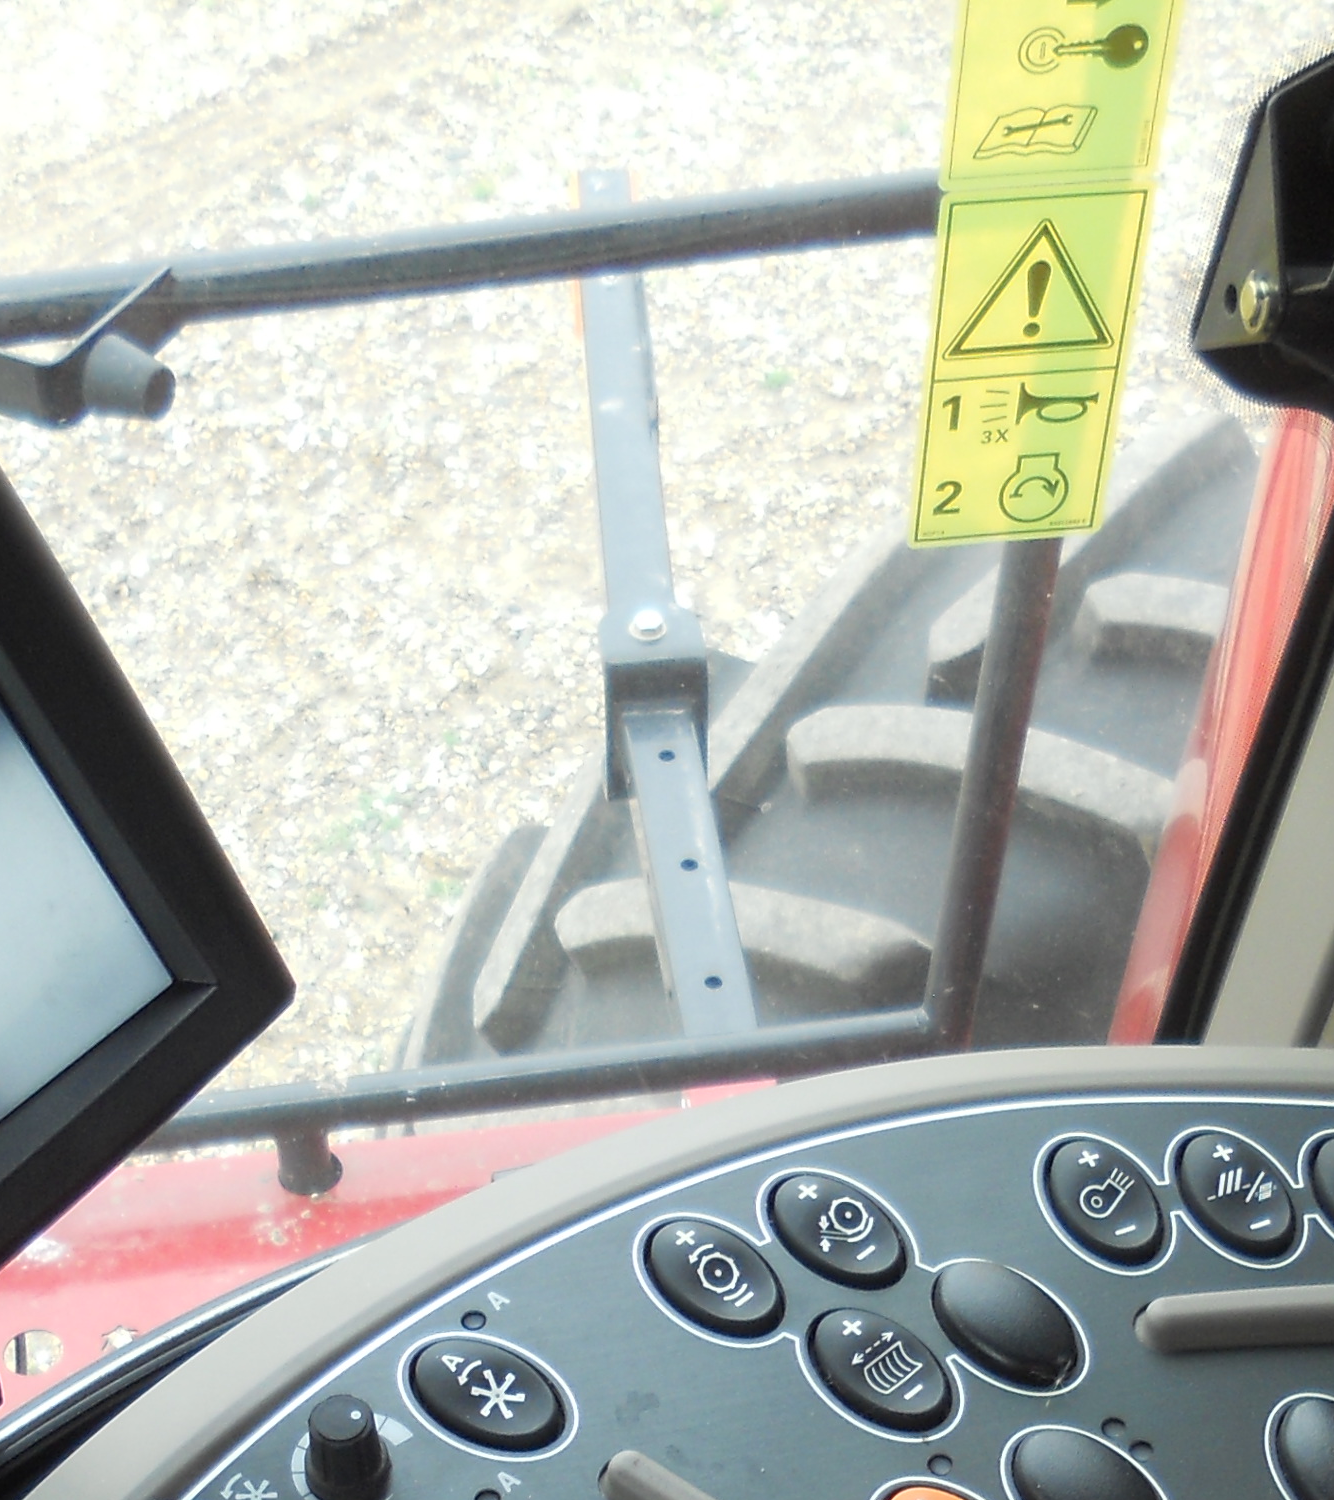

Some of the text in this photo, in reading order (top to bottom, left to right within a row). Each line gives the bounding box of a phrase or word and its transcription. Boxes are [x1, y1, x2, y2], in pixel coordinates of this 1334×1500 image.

[942, 395, 962, 431] 1
[980, 429, 1009, 444] 3X
[932, 480, 962, 516] 2
[487, 1291, 511, 1311] A
[440, 1354, 464, 1372] A
[497, 1471, 521, 1493] A
